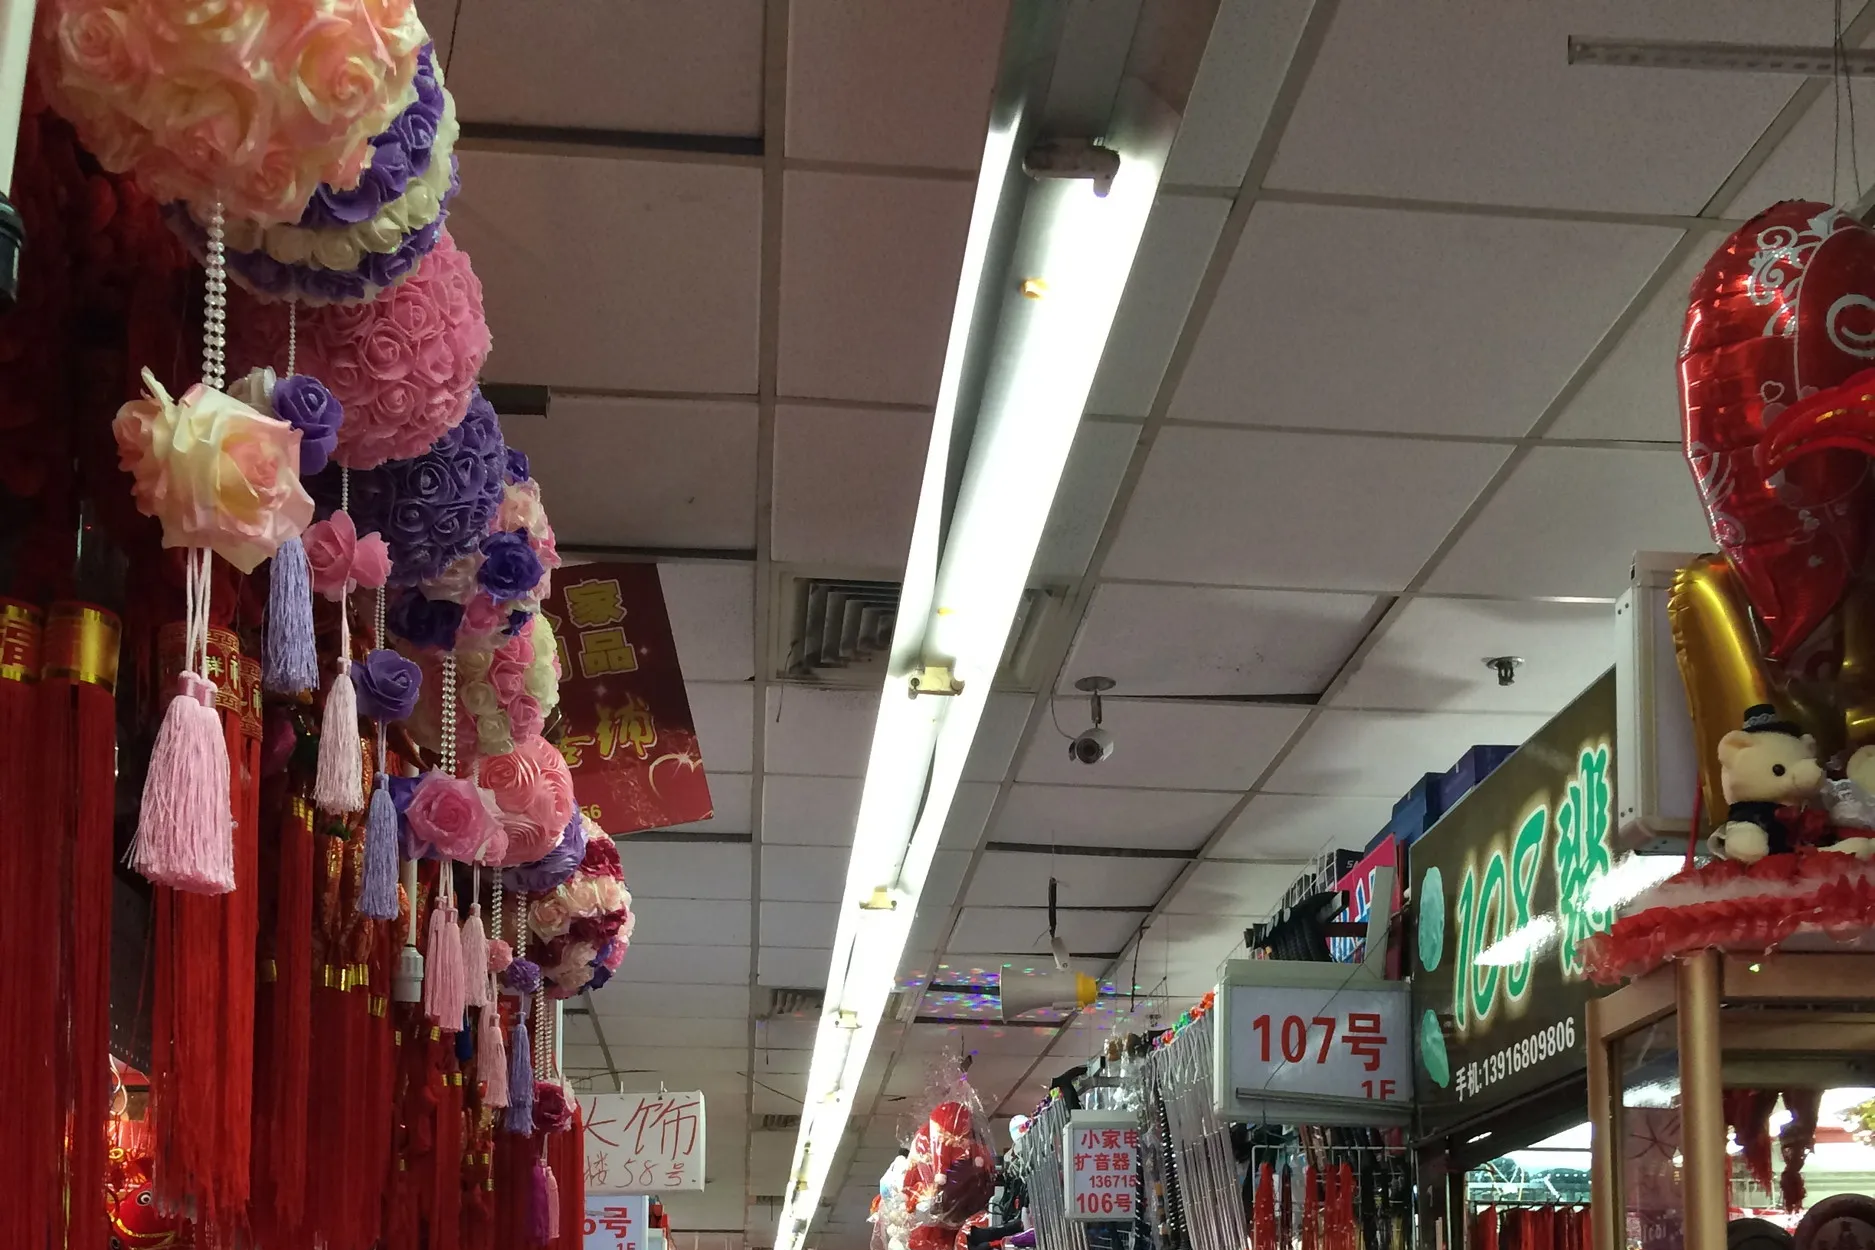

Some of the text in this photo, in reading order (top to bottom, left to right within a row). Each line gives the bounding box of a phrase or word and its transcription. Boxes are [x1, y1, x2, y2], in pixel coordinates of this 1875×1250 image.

[543, 580, 627, 634] 家
[555, 627, 638, 682] 品
[1253, 1013, 1387, 1072] 107号
[1074, 1152, 1131, 1172] 扩音器
[1076, 1192, 1132, 1214] 106号
